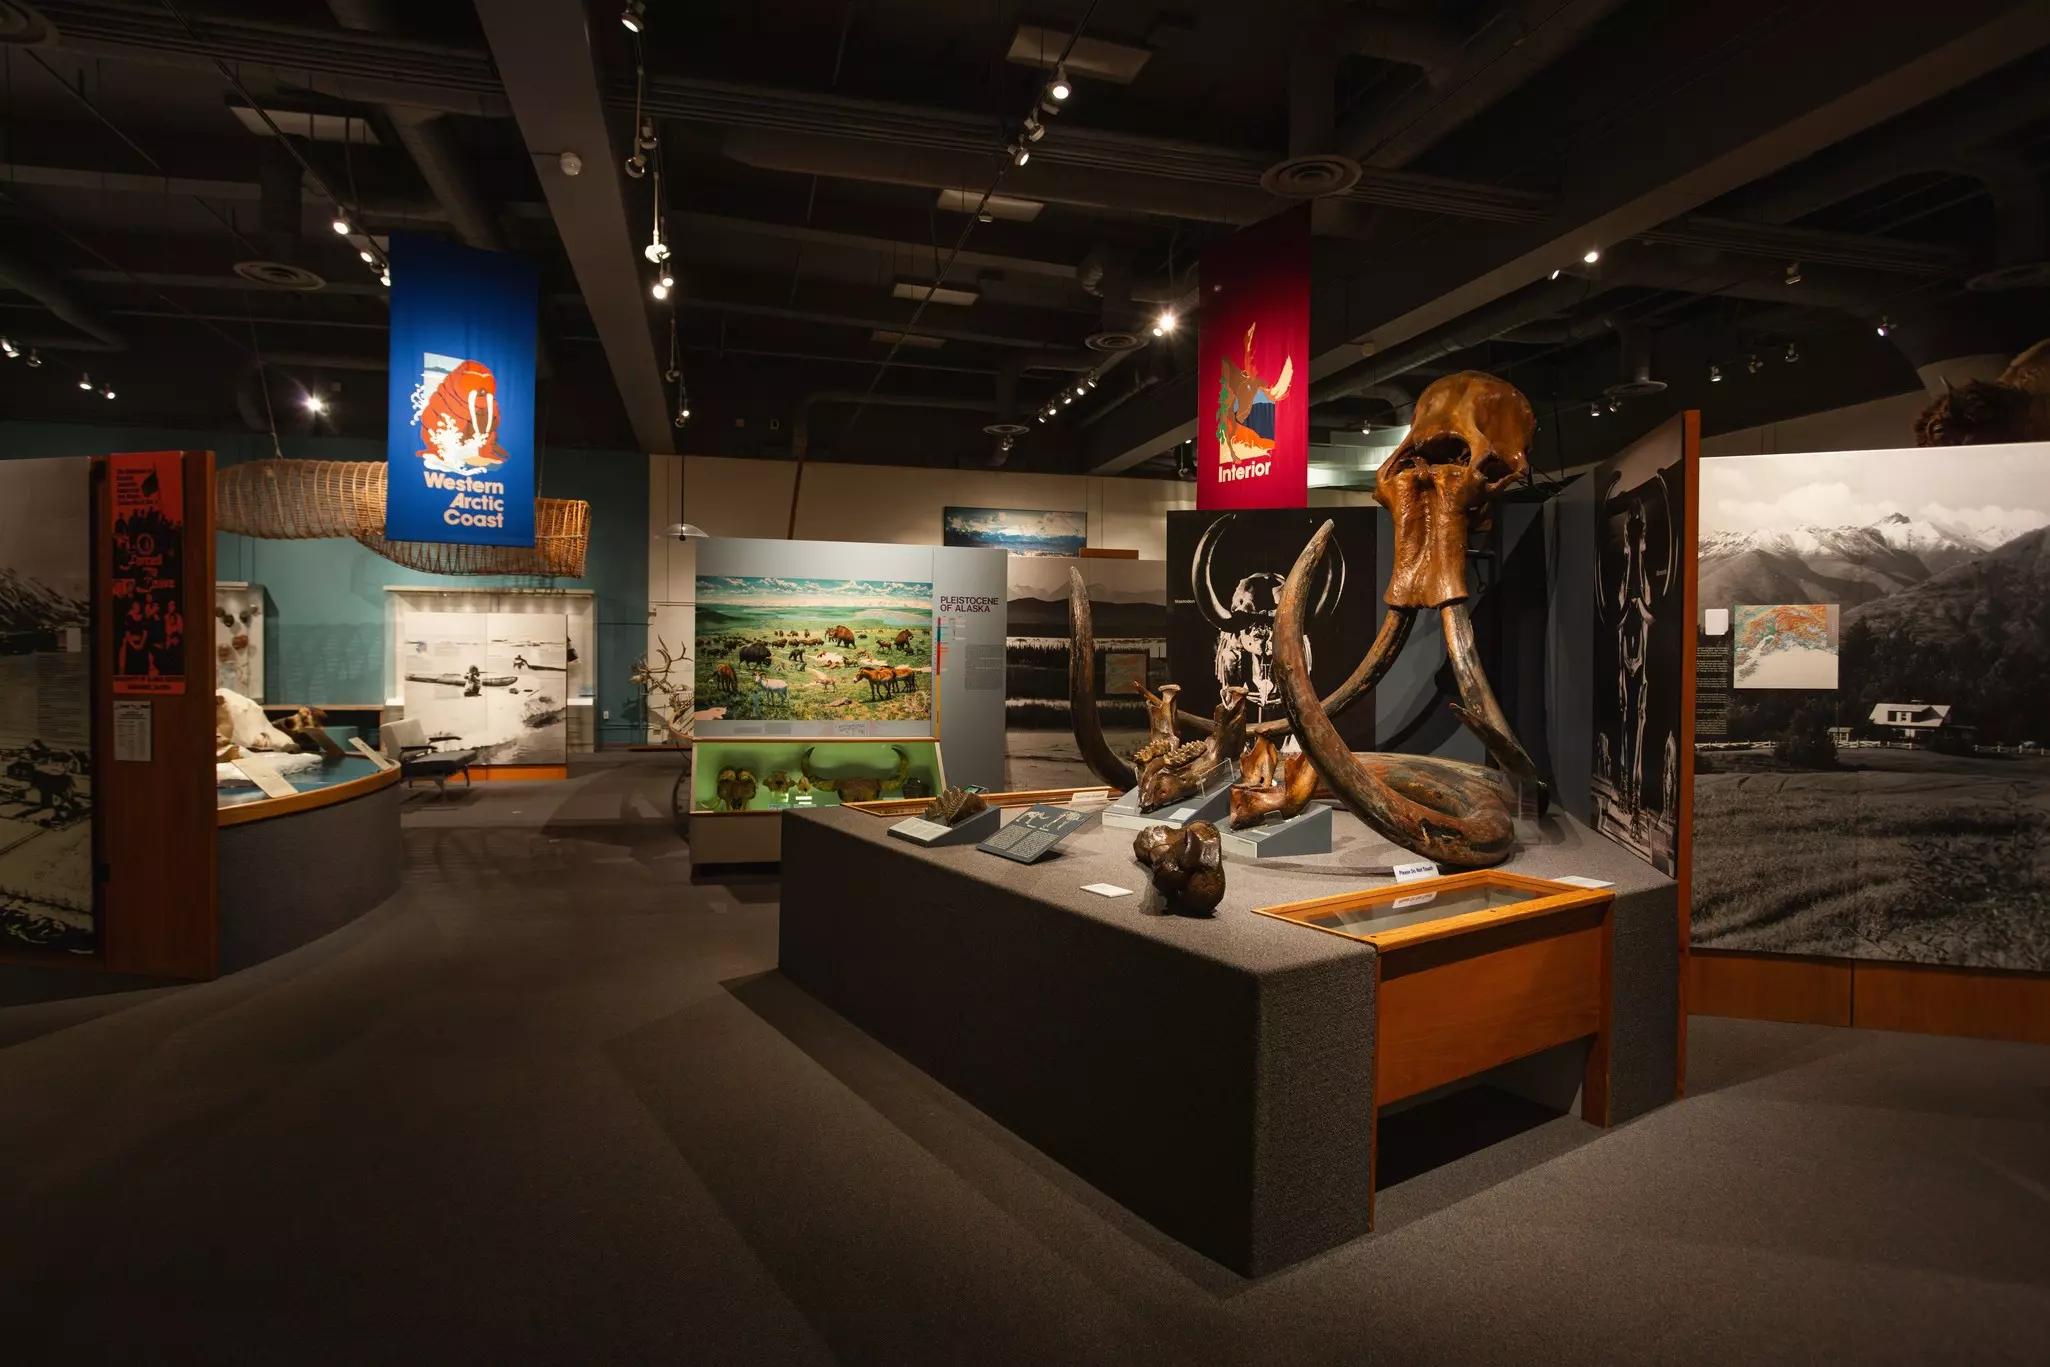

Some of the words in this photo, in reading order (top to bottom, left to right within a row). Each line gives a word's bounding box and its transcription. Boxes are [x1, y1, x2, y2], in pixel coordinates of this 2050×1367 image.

[1218, 460, 1272, 483] Interior
[423, 471, 504, 494] Western
[449, 492, 504, 511] Arctic
[443, 508, 504, 528] Coast
[940, 596, 999, 605] PLEISTOCENE
[940, 604, 952, 612] OF
[955, 605, 990, 613] ALASKA
